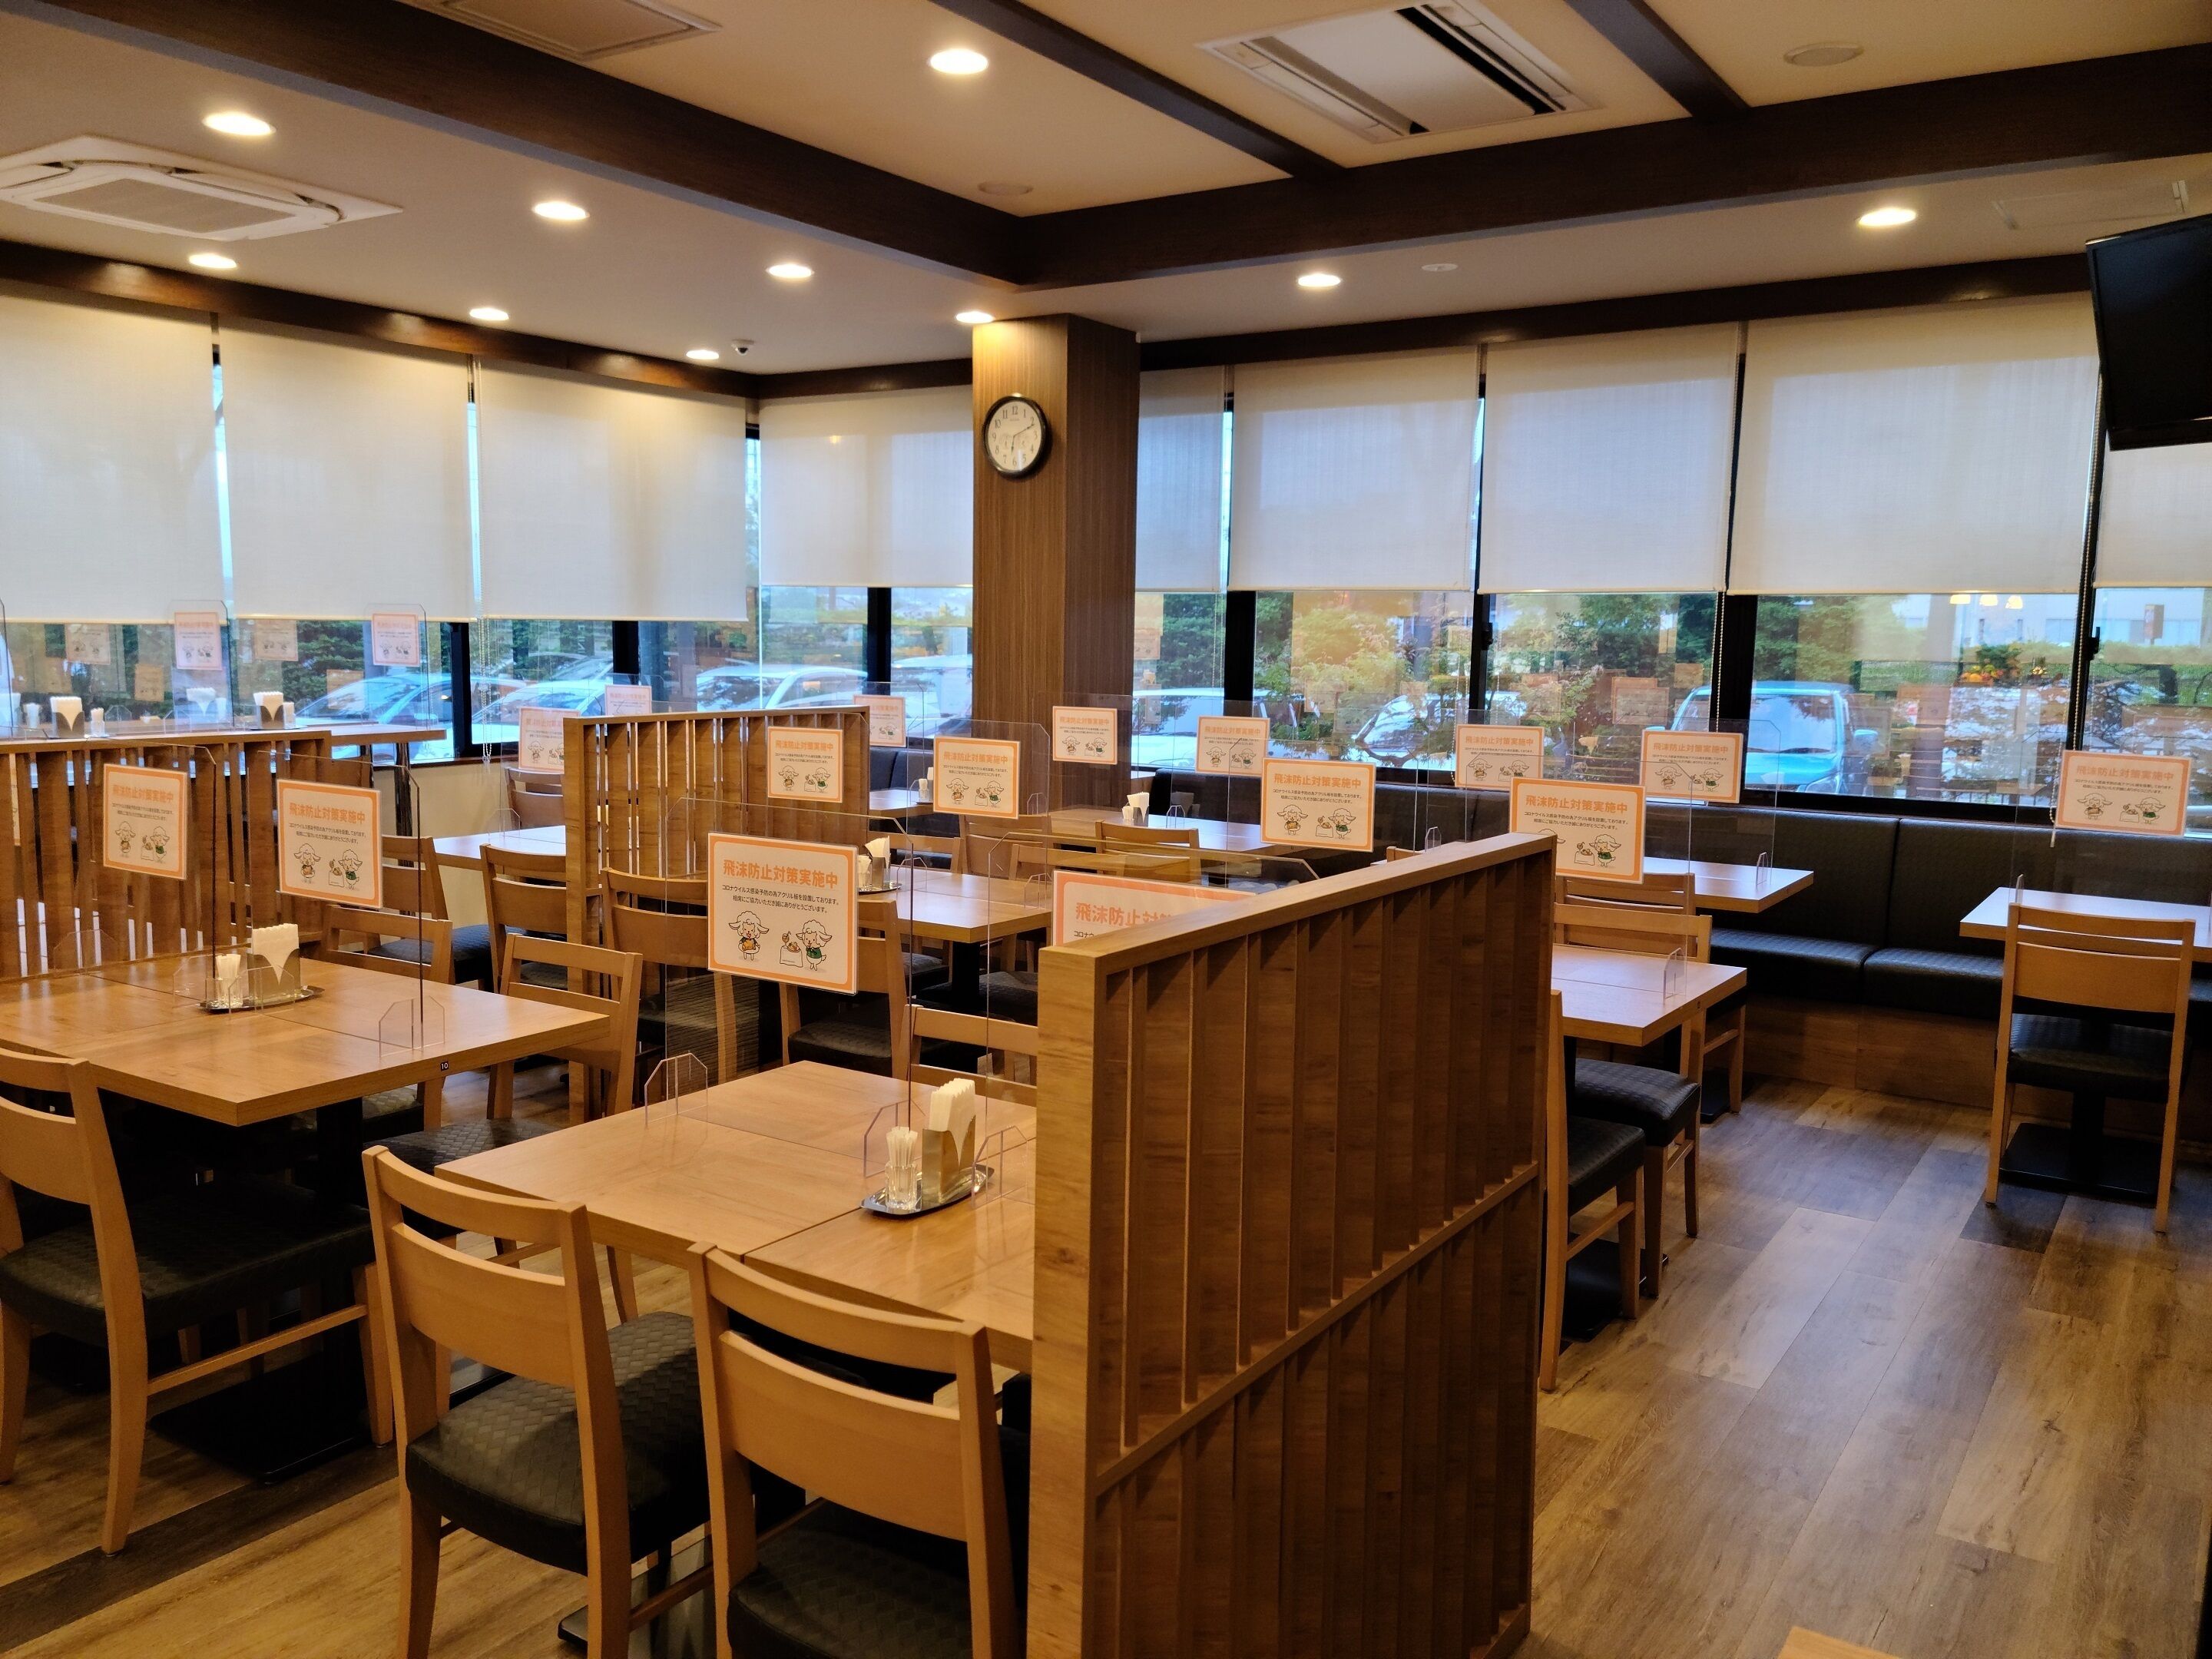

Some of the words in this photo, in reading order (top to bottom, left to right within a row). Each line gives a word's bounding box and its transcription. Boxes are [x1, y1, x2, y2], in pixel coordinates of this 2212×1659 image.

[1002, 409, 1008, 419] 11
[1012, 406, 1018, 415] 12
[995, 419, 1002, 429] 10
[1274, 773, 1362, 789] 飛沫防止対策実施中
[1525, 795, 1628, 814] 飛沫防止対策実施中
[723, 859, 838, 889] 飛沫防止対策実施中
